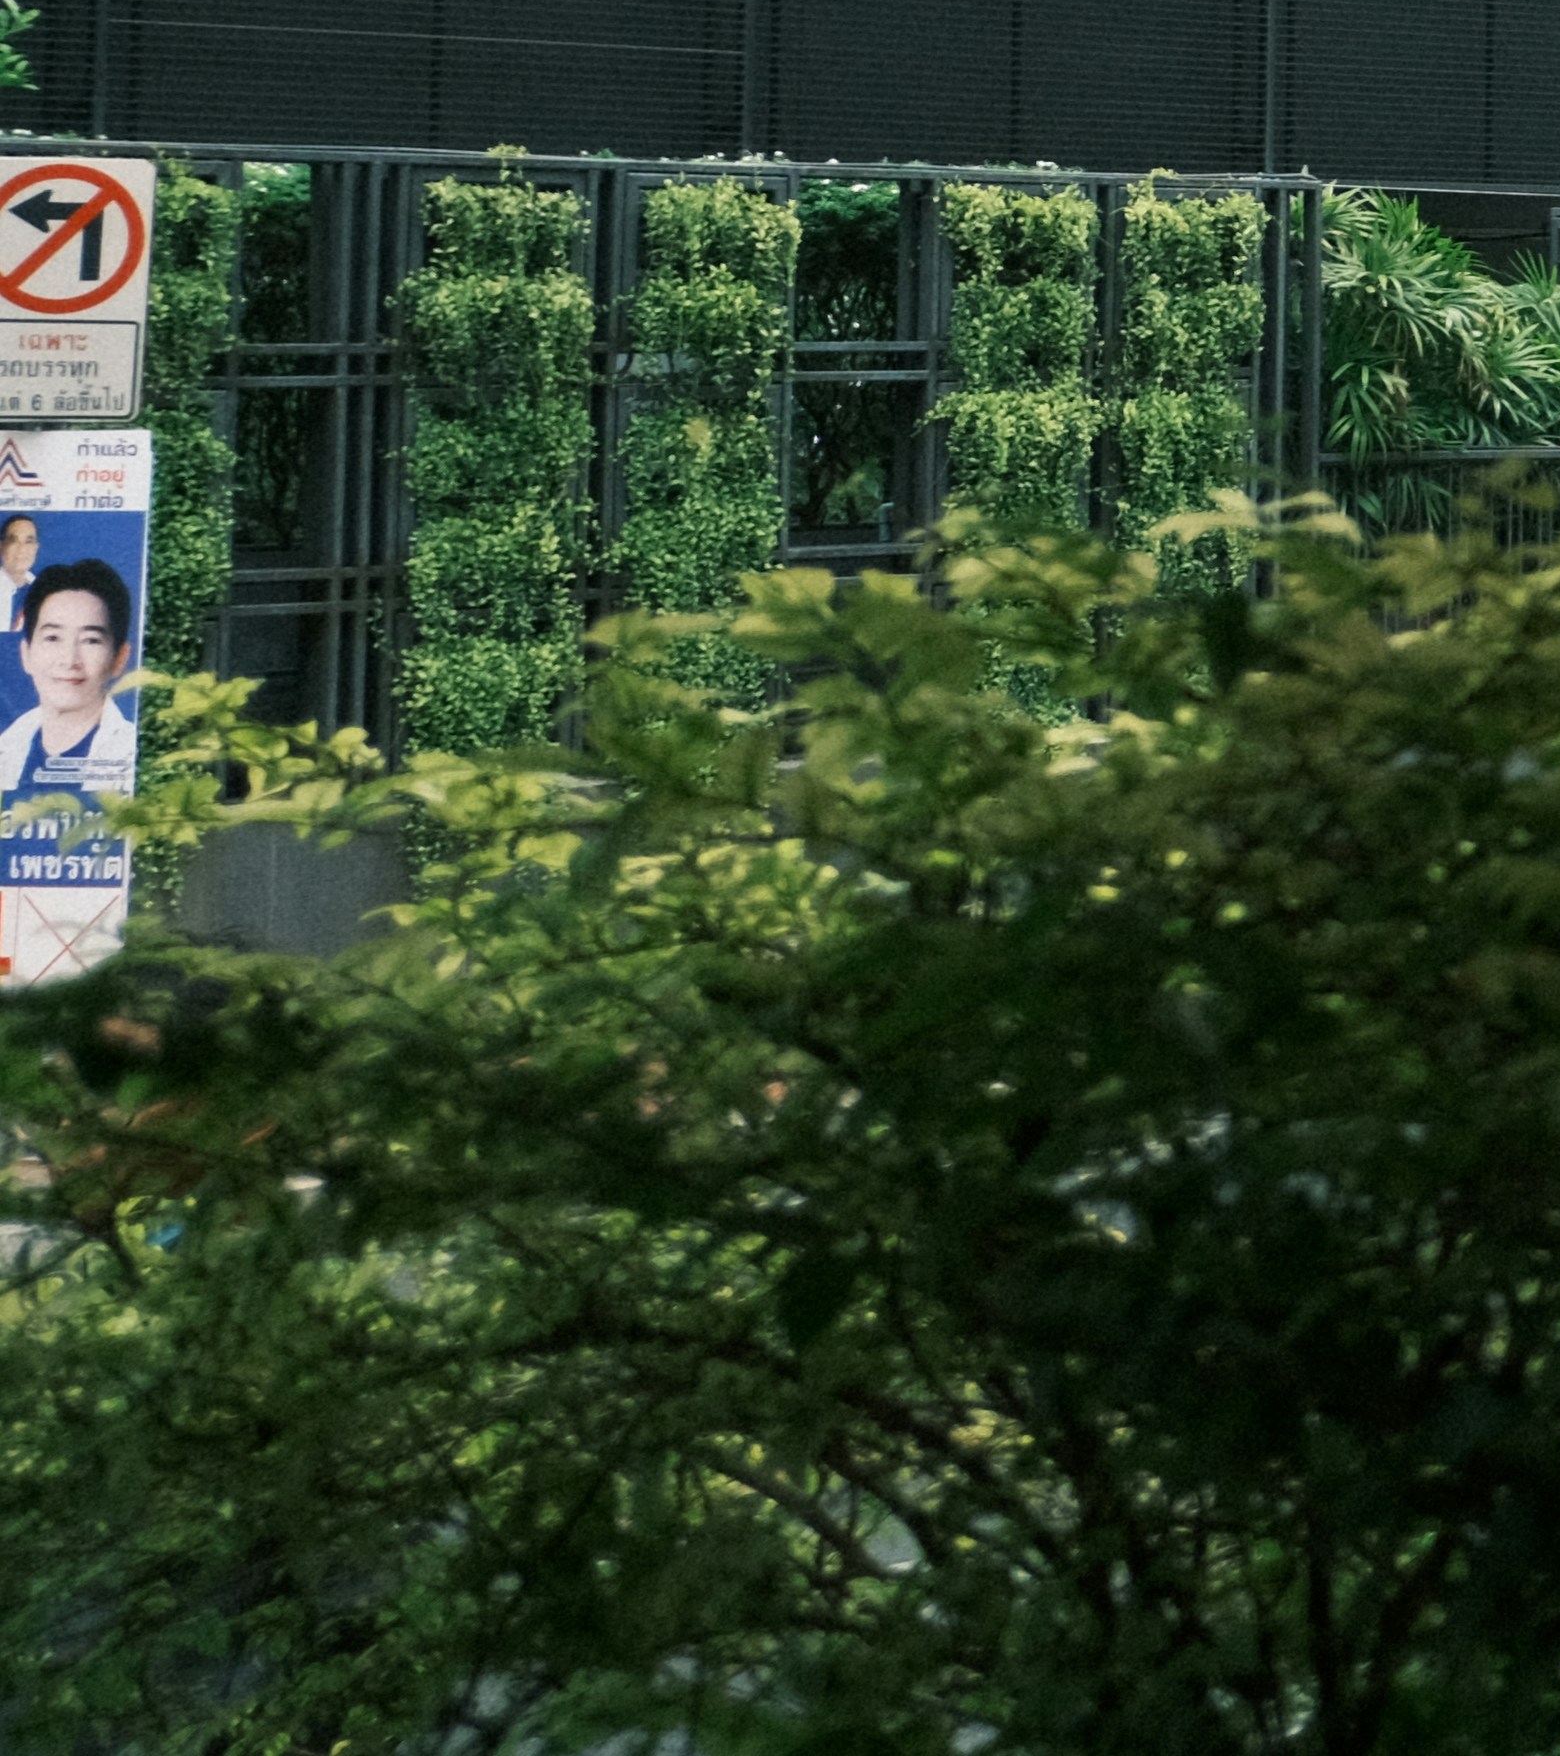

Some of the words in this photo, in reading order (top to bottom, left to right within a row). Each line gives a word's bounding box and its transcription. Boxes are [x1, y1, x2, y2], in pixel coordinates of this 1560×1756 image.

[18, 333, 88, 352] เฉพาะ
[31, 393, 43, 411] 6
[77, 438, 138, 456] ทำแล้ว
[76, 464, 126, 489] ทำอยู่
[75, 489, 124, 509] ทำต่อ
